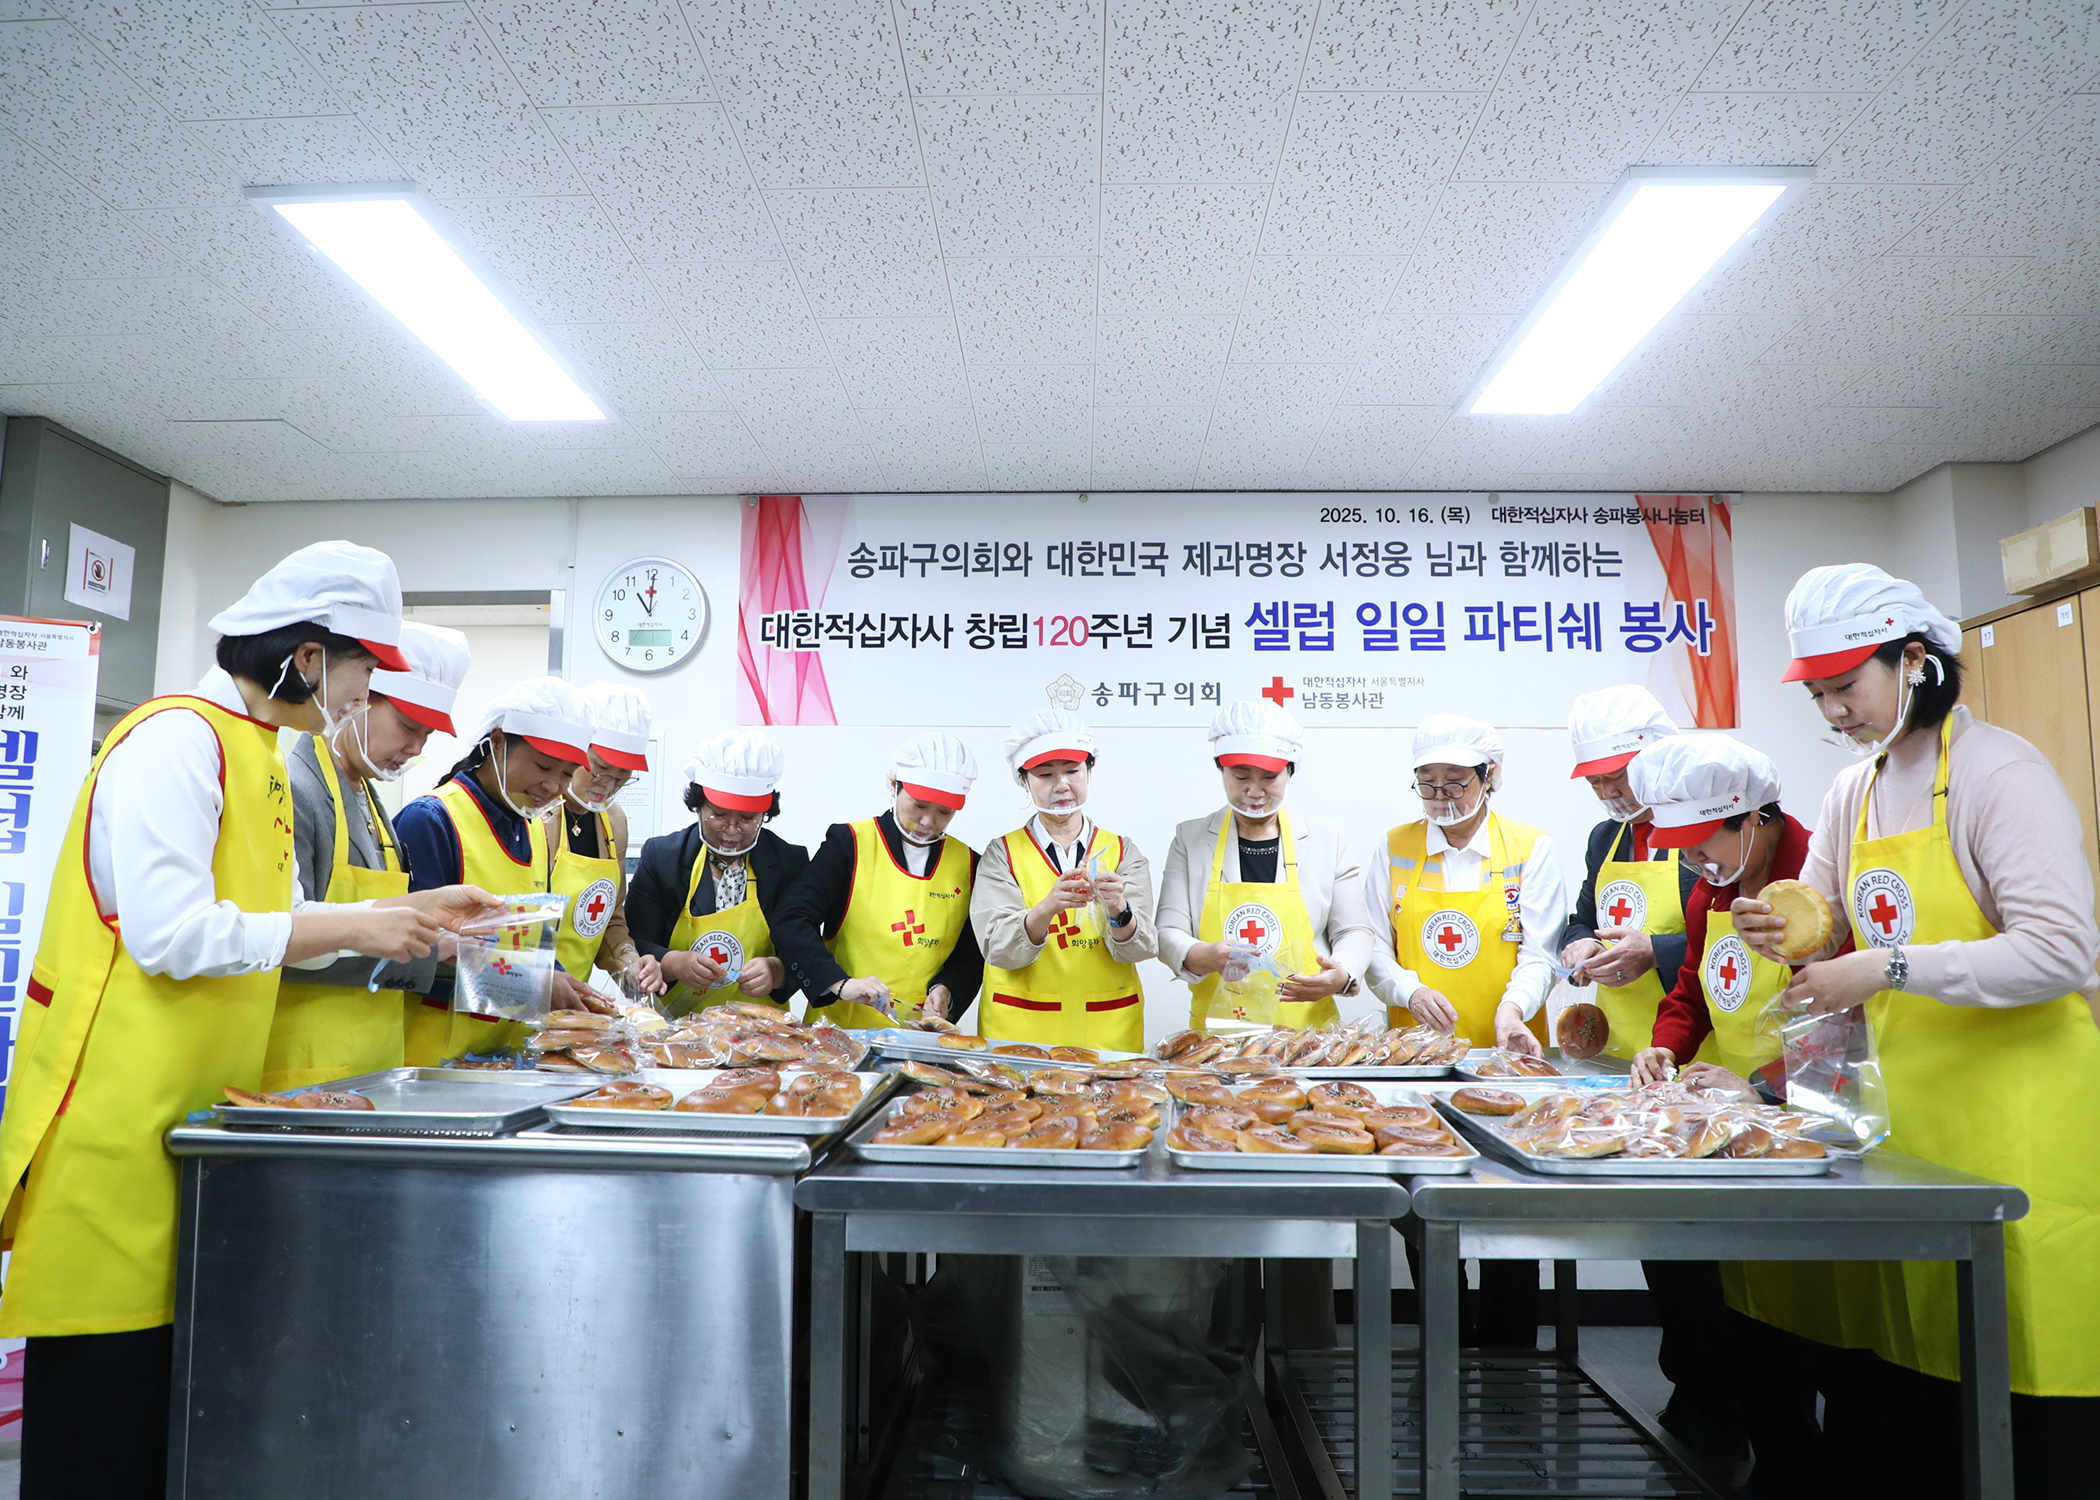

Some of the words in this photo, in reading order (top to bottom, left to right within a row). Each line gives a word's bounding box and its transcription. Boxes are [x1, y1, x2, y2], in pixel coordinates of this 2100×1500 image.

[1320, 507, 1367, 524] 2025.
[1376, 507, 1400, 524] 10.
[1408, 507, 1434, 524] 16.
[1441, 506, 1471, 525] (목)
[1491, 506, 1588, 524] 대한적십자사
[1592, 506, 1706, 525] 송파봉사나눔터
[847, 541, 1033, 578] 송파구의회와
[1047, 541, 1169, 577] 대한민국
[1182, 541, 1307, 578] 제과명장
[1319, 541, 1412, 578] 서정웅
[1426, 541, 1487, 577] 님과
[1499, 541, 1623, 578] 함께하는
[645, 569, 658, 580] 12
[625, 576, 636, 587] 11
[670, 576, 675, 587] 1
[612, 589, 626, 601] 10
[682, 588, 691, 600] 2
[605, 609, 613, 621] 9
[688, 608, 696, 620] 3
[761, 612, 954, 650] 대한적십자사
[965, 612, 1154, 649] 창립120주년
[1168, 612, 1231, 650] 기념
[1245, 600, 1335, 652] 셀럽
[1356, 601, 1447, 652] 일일
[1463, 600, 1602, 653] 파티쉐
[1619, 600, 1714, 653] 봉사
[611, 630, 620, 642] 8
[680, 630, 689, 641] 4
[1844, 627, 1888, 641] 대한적십자사
[1984, 632, 1991, 641] 17
[625, 647, 631, 655] 7
[645, 649, 653, 661] 6
[668, 647, 675, 656] 5
[10, 665, 29, 680] 와
[1303, 676, 1366, 688] 대한적십자사
[1371, 676, 1425, 687] 서울특별지사
[1091, 682, 1221, 707] 송파구의회
[1302, 692, 1384, 709] 남동봉사관
[1699, 804, 1734, 816] 대한적십자사
[1600, 886, 1619, 910] KOREAN
[1620, 885, 1634, 894] RED
[1633, 891, 1644, 914] CROSS
[1857, 879, 1871, 918] KOREAN
[1871, 875, 1890, 885] RED
[1891, 879, 1909, 910] CROSS
[1228, 910, 1246, 934] KOREAN
[1261, 911, 1277, 931] CROSS
[1426, 916, 1442, 939] KOREAN
[1457, 917, 1475, 938] CROSS
[709, 934, 723, 942] RED
[723, 936, 740, 956] CROSS
[1072, 938, 1100, 949] 희망풍차
[1710, 941, 1729, 970] KOREAN
[1737, 948, 1748, 976] CROSS
